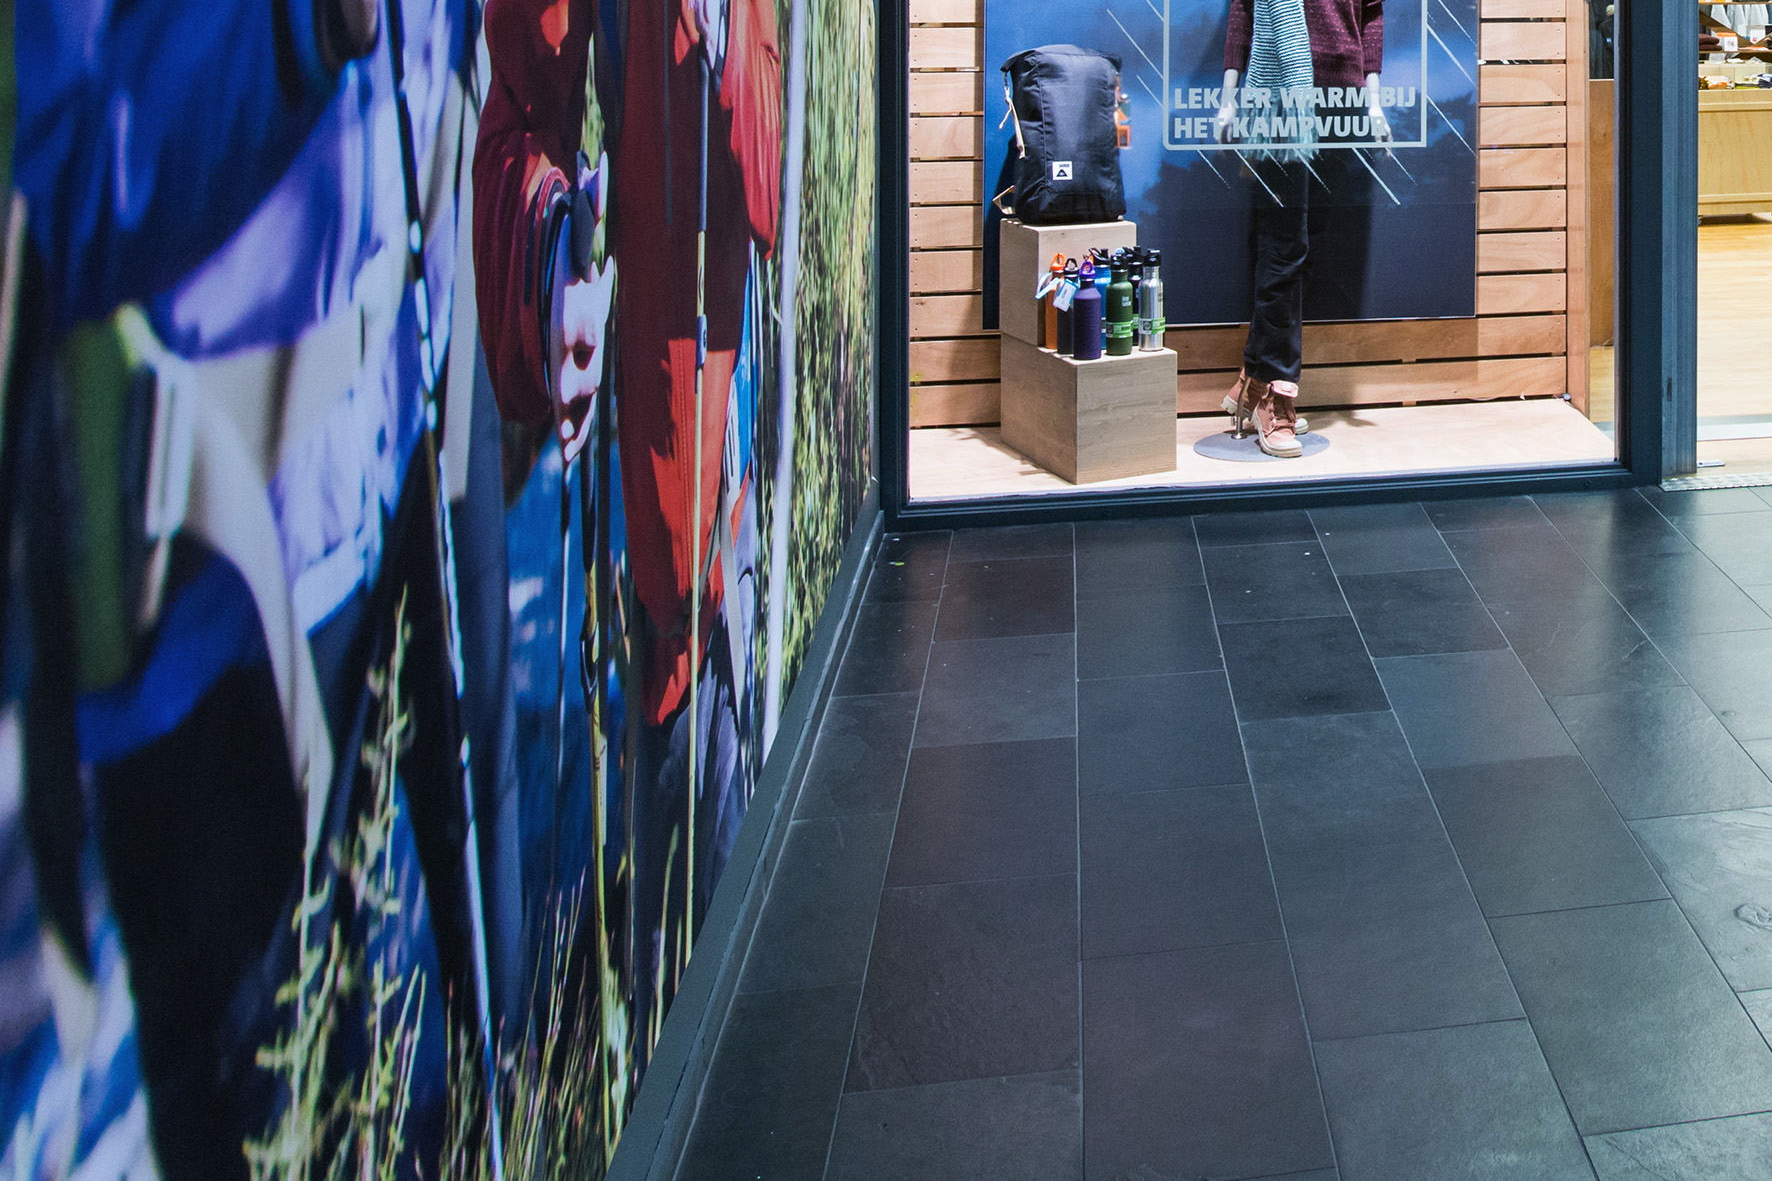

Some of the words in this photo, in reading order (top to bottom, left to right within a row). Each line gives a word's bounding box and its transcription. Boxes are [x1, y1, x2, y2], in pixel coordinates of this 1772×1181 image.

[1174, 86, 1272, 109] LEKKER
[1279, 86, 1370, 108] WARM
[1380, 86, 1416, 108] BIJ
[1174, 117, 1224, 138] HET
[1232, 115, 1387, 138] KAMPVUUR
